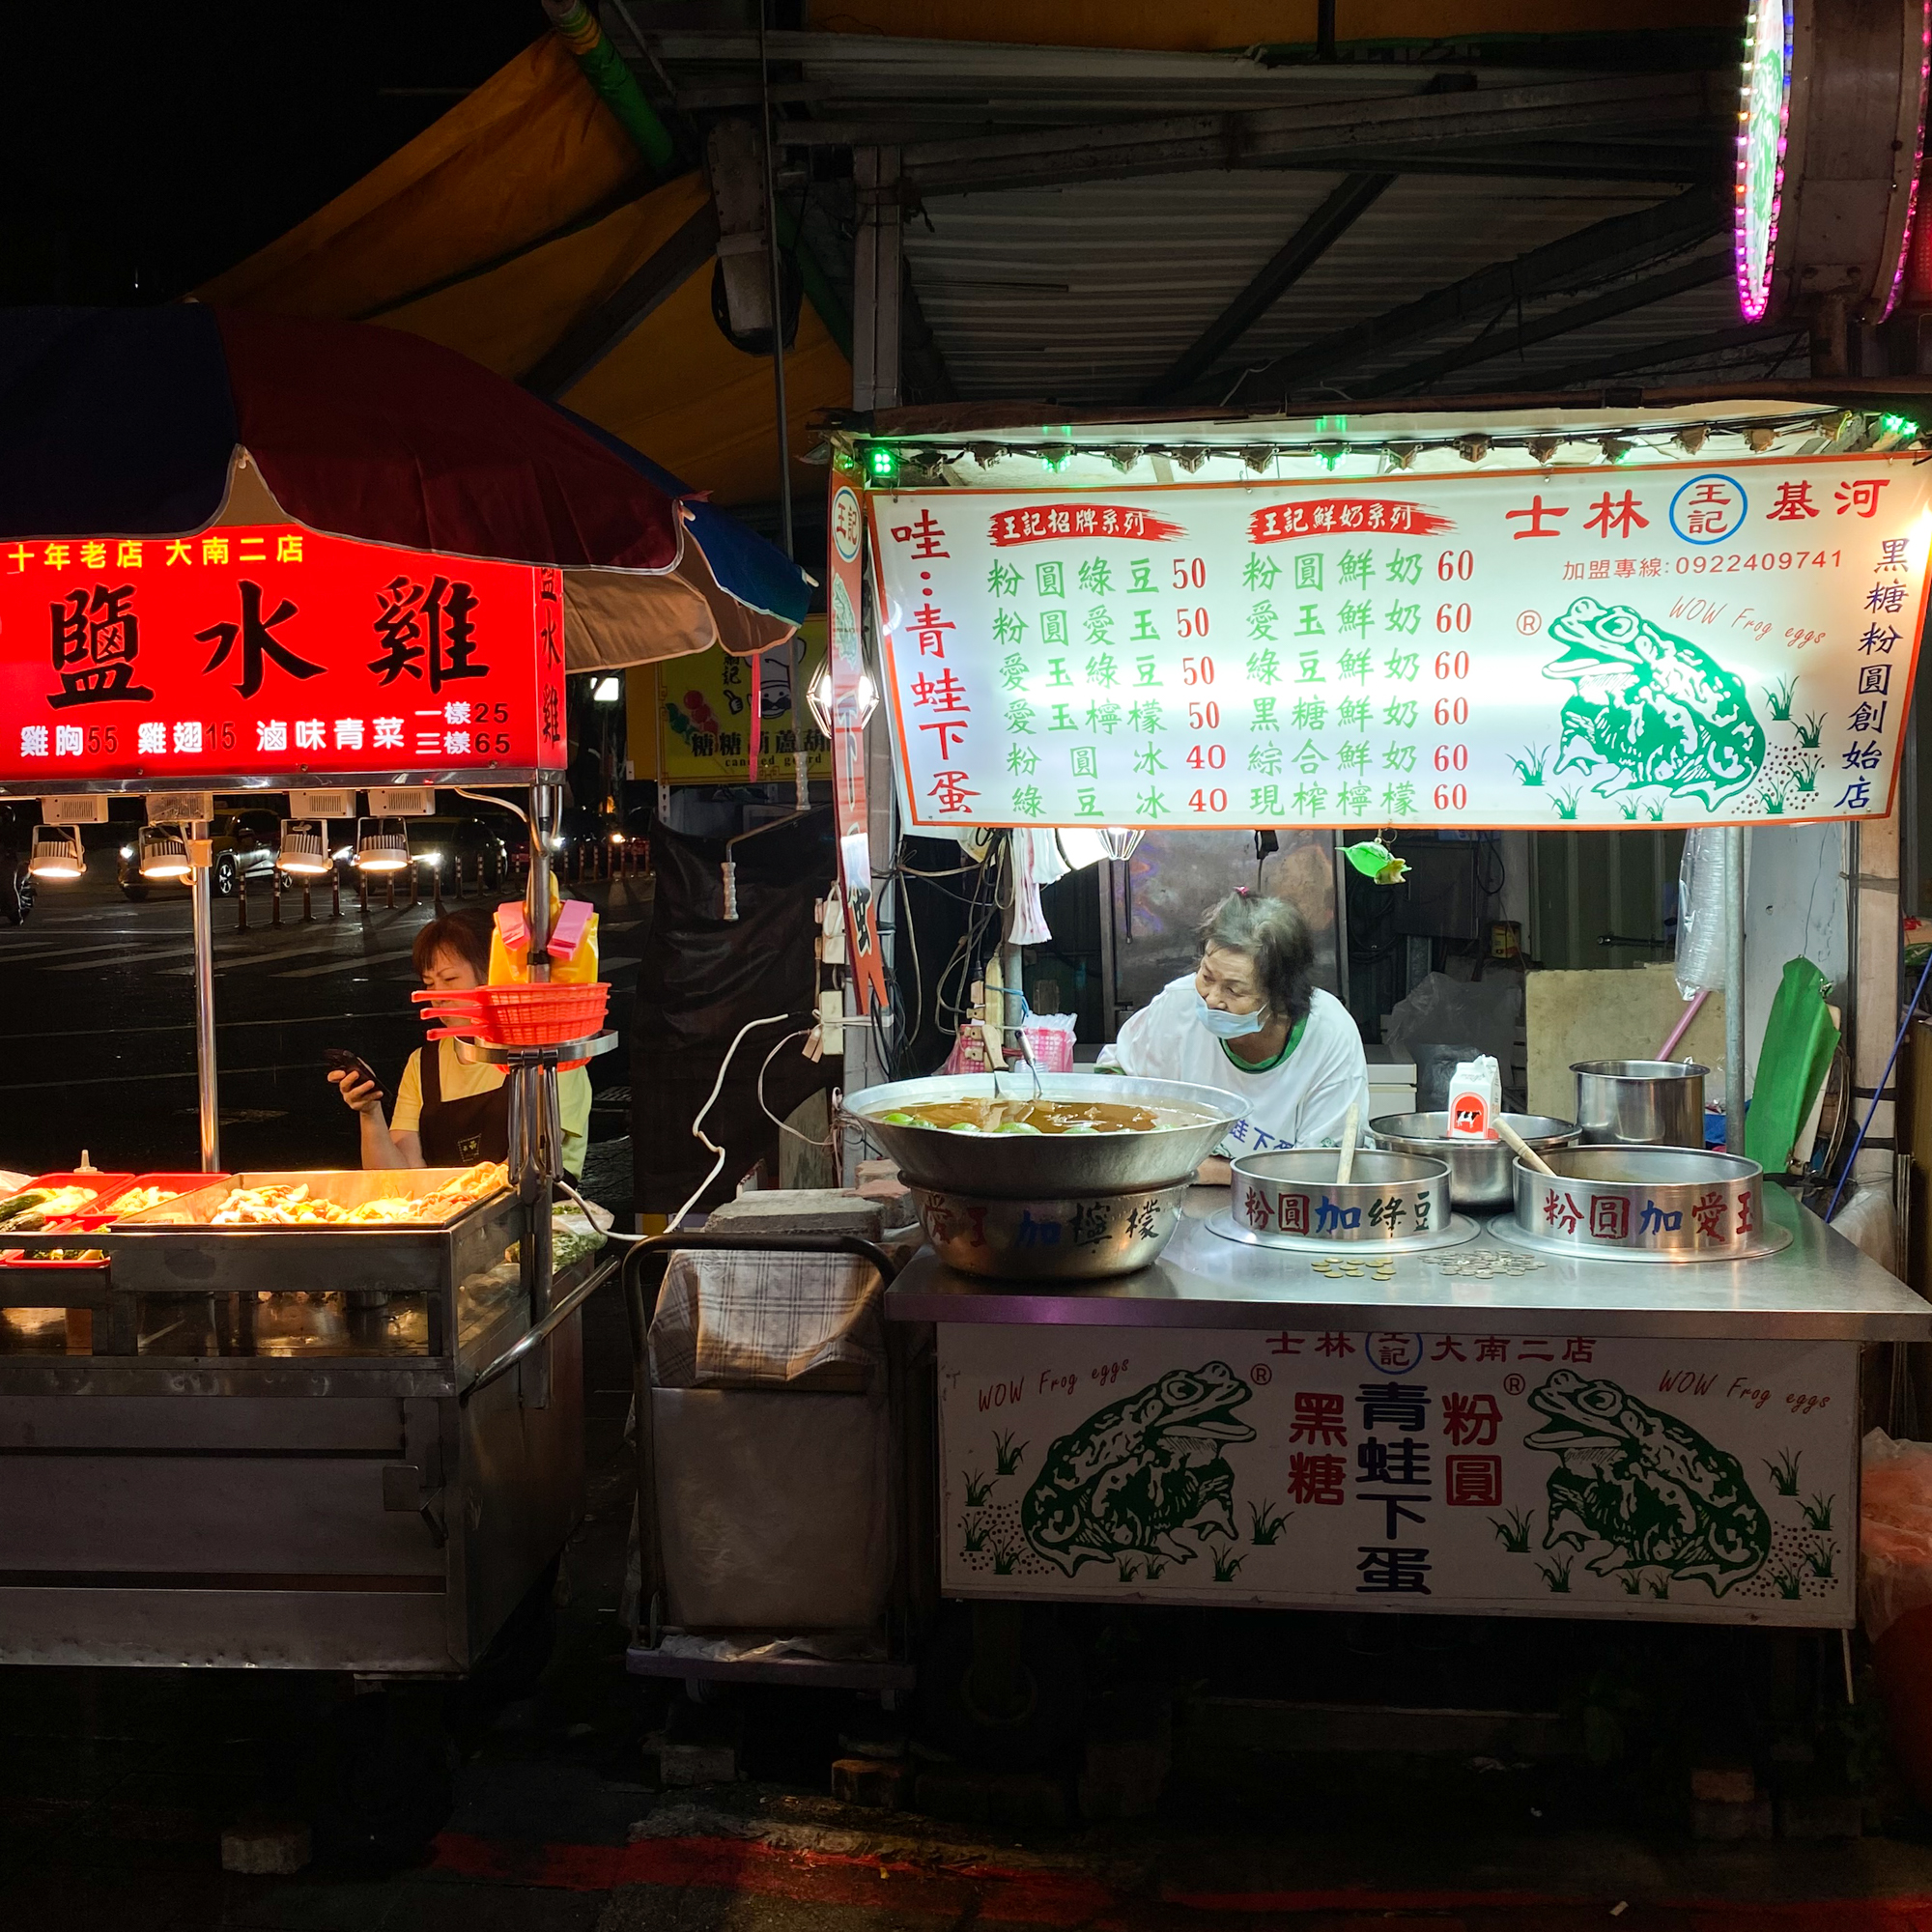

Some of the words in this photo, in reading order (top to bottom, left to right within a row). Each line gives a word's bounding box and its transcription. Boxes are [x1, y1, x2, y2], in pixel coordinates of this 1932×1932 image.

[1003, 508, 1146, 539] 王記招牌系列
[1263, 503, 1413, 536] 王記鮮奶系列
[1505, 489, 1650, 539] 士林
[1687, 483, 1732, 534] 王記
[1766, 479, 1890, 521] 基河
[8, 540, 143, 572] 十年老店
[166, 536, 303, 566] 大南二店
[1242, 548, 1424, 591] 粉圓鮮奶
[1437, 550, 1474, 581] 60
[987, 556, 1159, 599] 粉圓綠豆
[1172, 557, 1207, 589] 50
[992, 605, 1160, 646] 粉圓愛玉
[1177, 607, 1209, 638] 50
[1246, 599, 1422, 640] 愛玉鮮奶
[1435, 603, 1472, 633] 60
[1669, 595, 1728, 624] WOW
[1731, 608, 1773, 641] Frog
[1784, 627, 1826, 649] eggs
[46, 575, 490, 710] 鹽水雞
[999, 652, 1164, 691] 愛玉綠豆
[1182, 656, 1214, 685] 50
[1246, 647, 1420, 686] 綠豆鮮奶
[1435, 650, 1469, 679] 60
[1833, 538, 1910, 809] 黑糖粉圓創始店
[1004, 697, 1168, 735] 愛玉檸檬
[1189, 700, 1220, 729] 50
[1249, 695, 1419, 732] 黑糖鮮奶
[1434, 696, 1468, 725] 60
[256, 717, 405, 751] 滷味青菜
[1006, 741, 1169, 779] 粉圓冰
[1186, 744, 1226, 769] 40
[1247, 738, 1418, 777] 綜合鮮奶
[1434, 744, 1468, 772] 60
[1011, 783, 1171, 819] 綠豆冰
[1188, 788, 1228, 812] 40
[1249, 780, 1419, 818] 現榨檸檬
[1434, 783, 1467, 810] 60
[1265, 1331, 1355, 1358] 士林
[1431, 1335, 1598, 1363] 大南二店
[979, 1376, 1024, 1411] WOW
[1039, 1369, 1077, 1395] Frog
[1092, 1358, 1129, 1382] eggs
[1659, 1369, 1719, 1396] WOW
[1726, 1377, 1772, 1408] Frog
[1786, 1391, 1831, 1413] eggs
[1287, 1391, 1348, 1506] 黑糖
[1442, 1391, 1503, 1506] 粉圓
[1354, 1381, 1432, 1595] 青蛙下蛋
